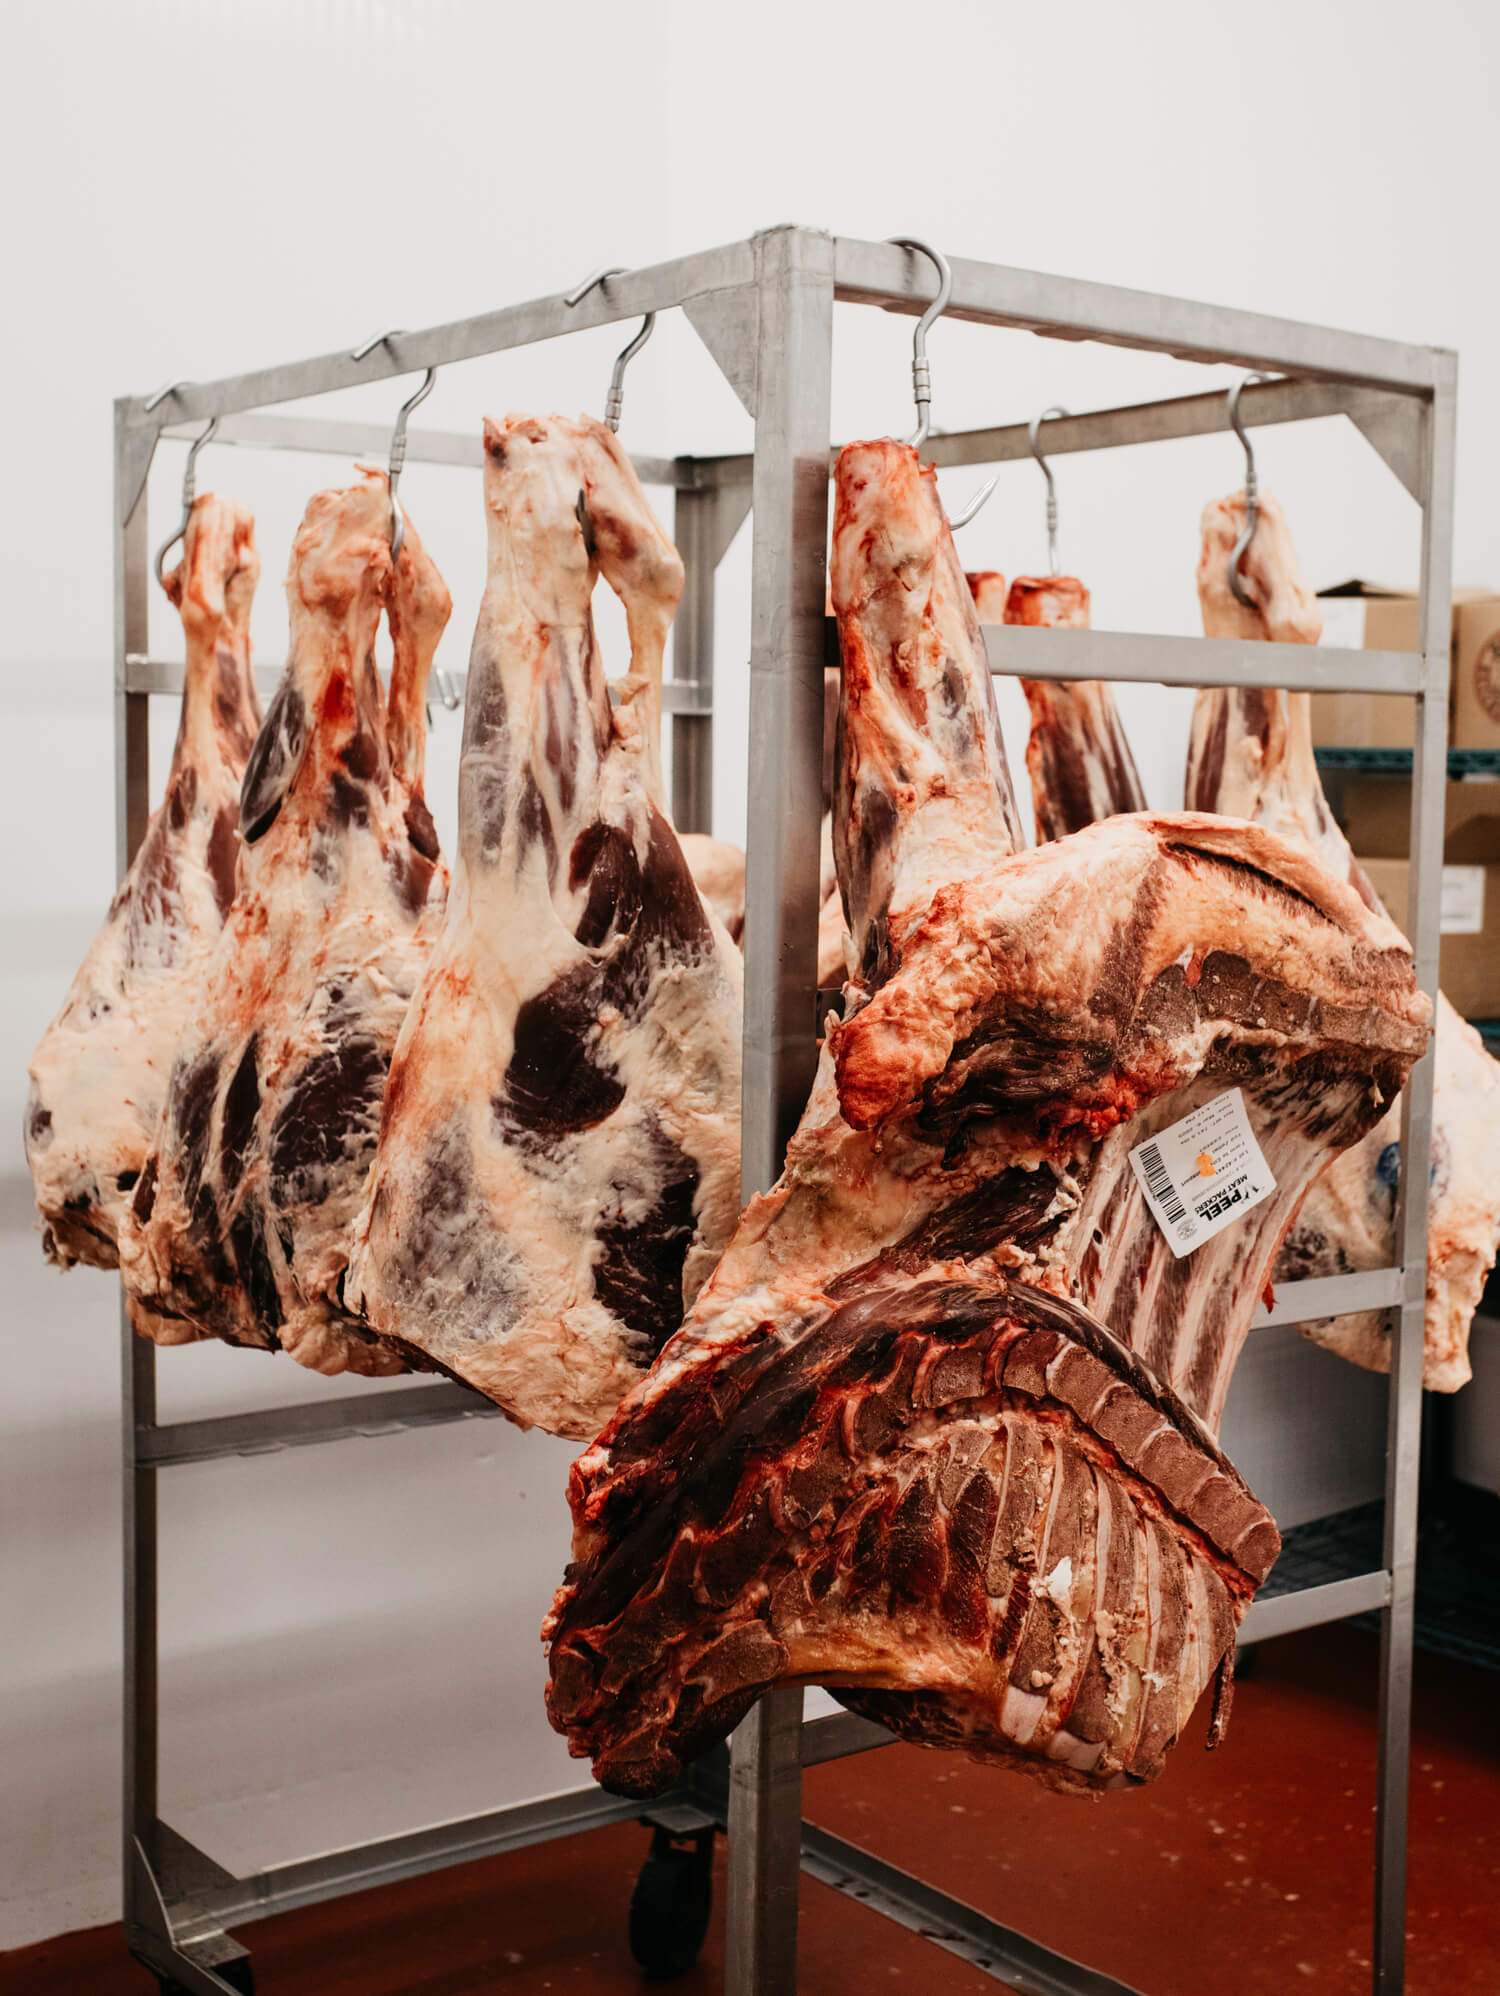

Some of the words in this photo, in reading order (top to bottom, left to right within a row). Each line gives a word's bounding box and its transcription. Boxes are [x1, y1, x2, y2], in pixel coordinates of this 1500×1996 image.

[1226, 1174, 1248, 1191] MEAT
[1195, 1189, 1227, 1214] PACKERS
[1200, 1189, 1242, 1221] PEEL
